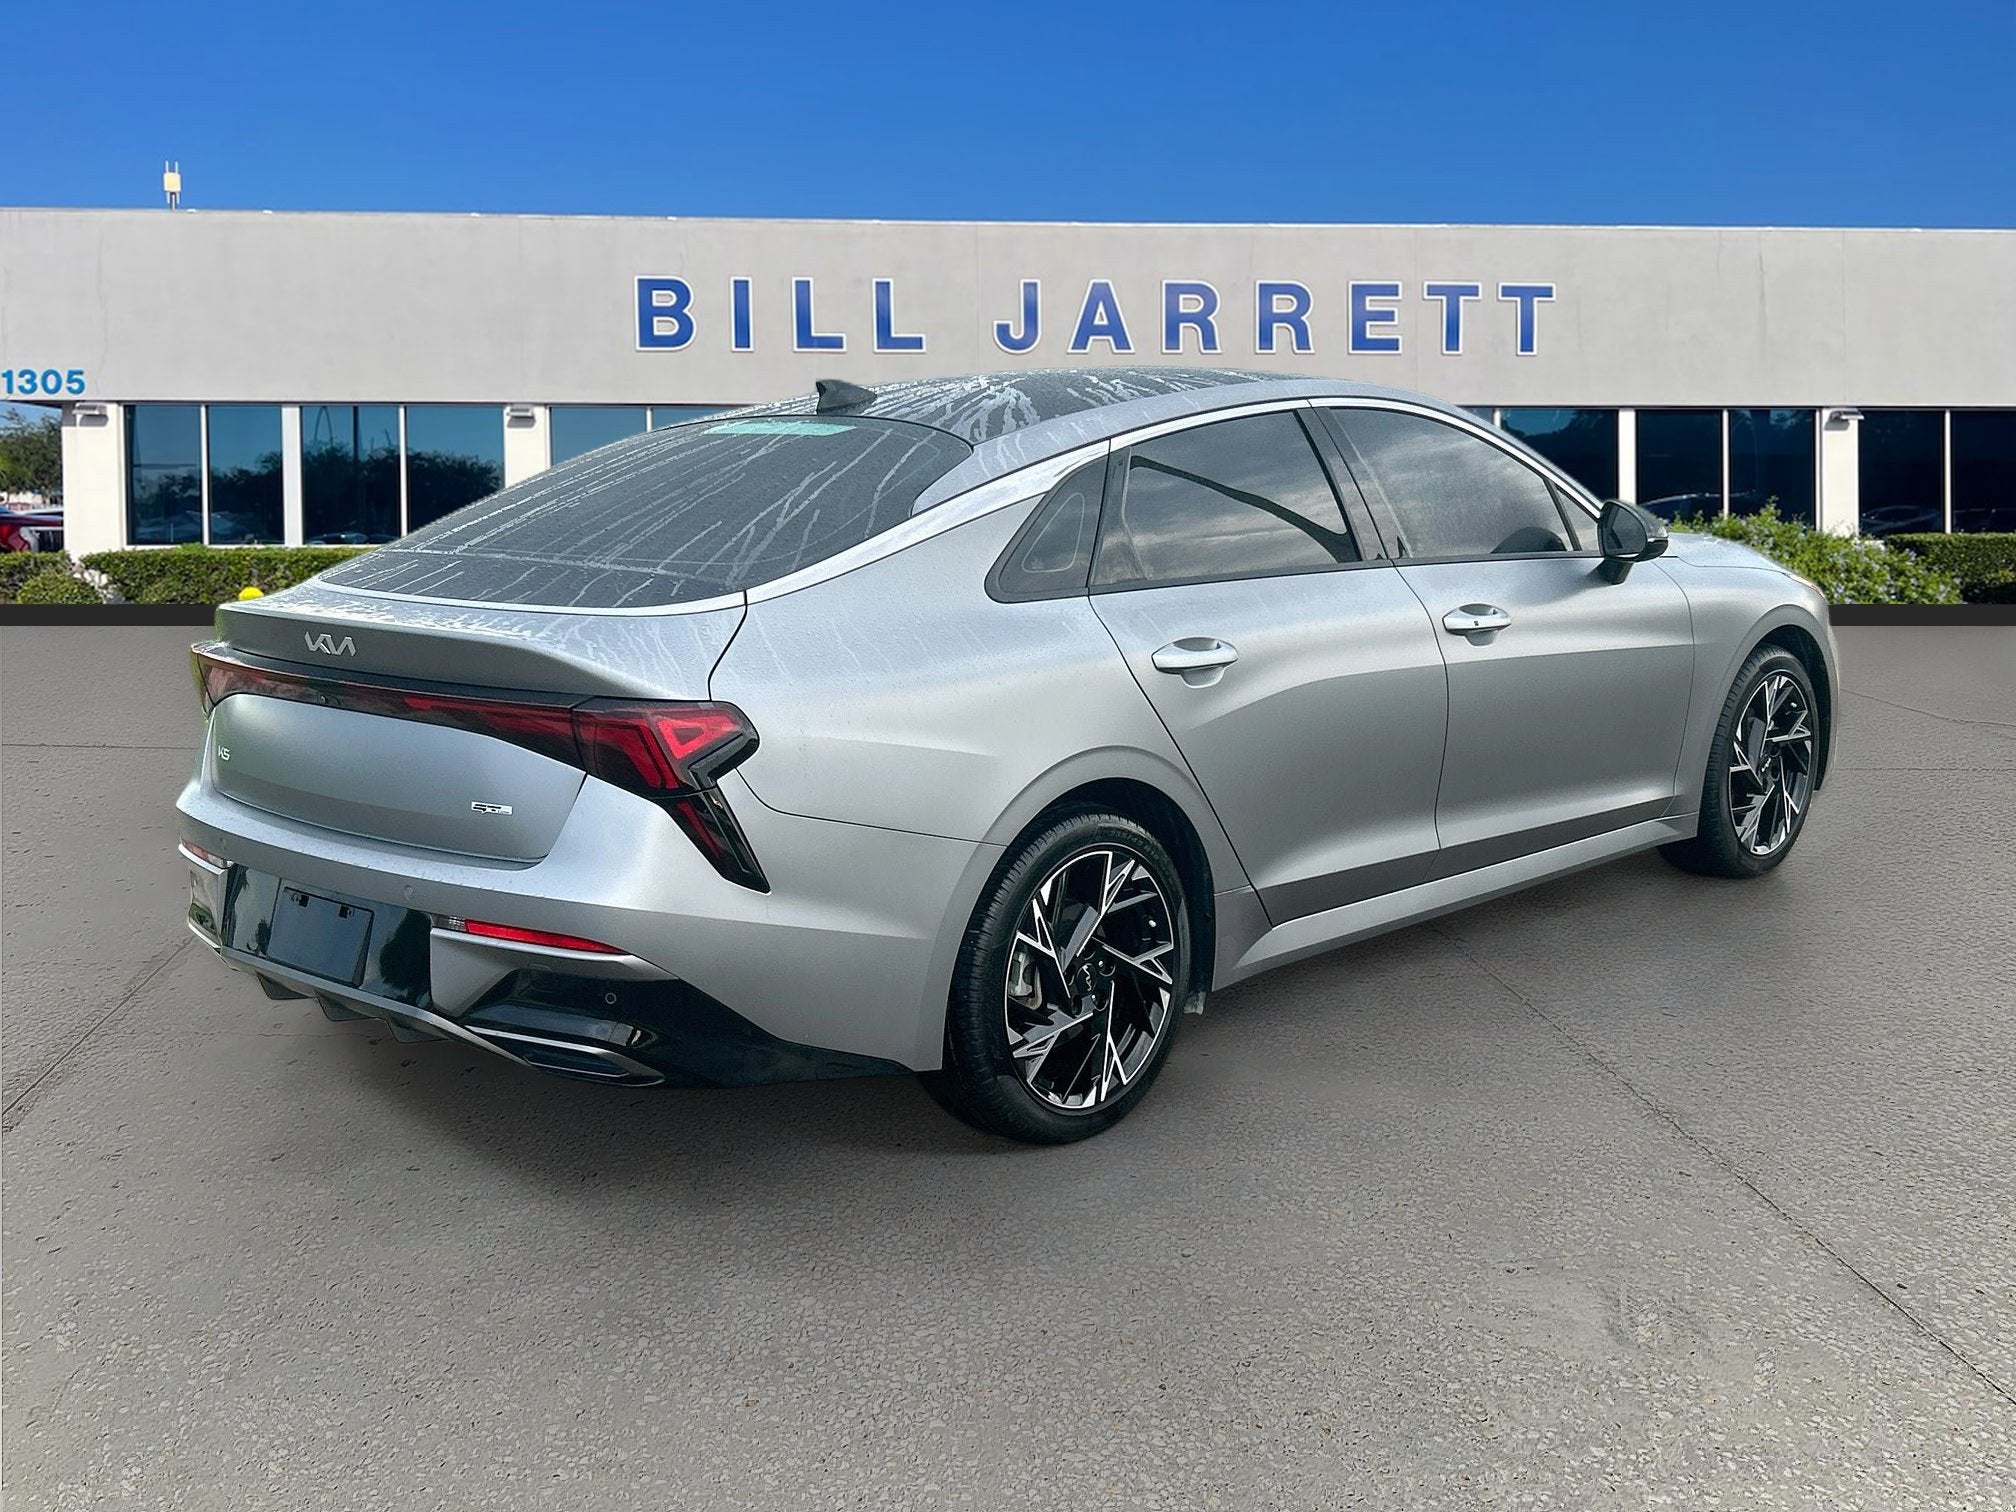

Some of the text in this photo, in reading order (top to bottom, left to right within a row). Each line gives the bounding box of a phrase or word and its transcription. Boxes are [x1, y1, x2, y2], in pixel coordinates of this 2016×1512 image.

[634, 275, 1556, 356] BILL JARRETT
[1, 368, 86, 395] 1305
[218, 745, 231, 761] K5
